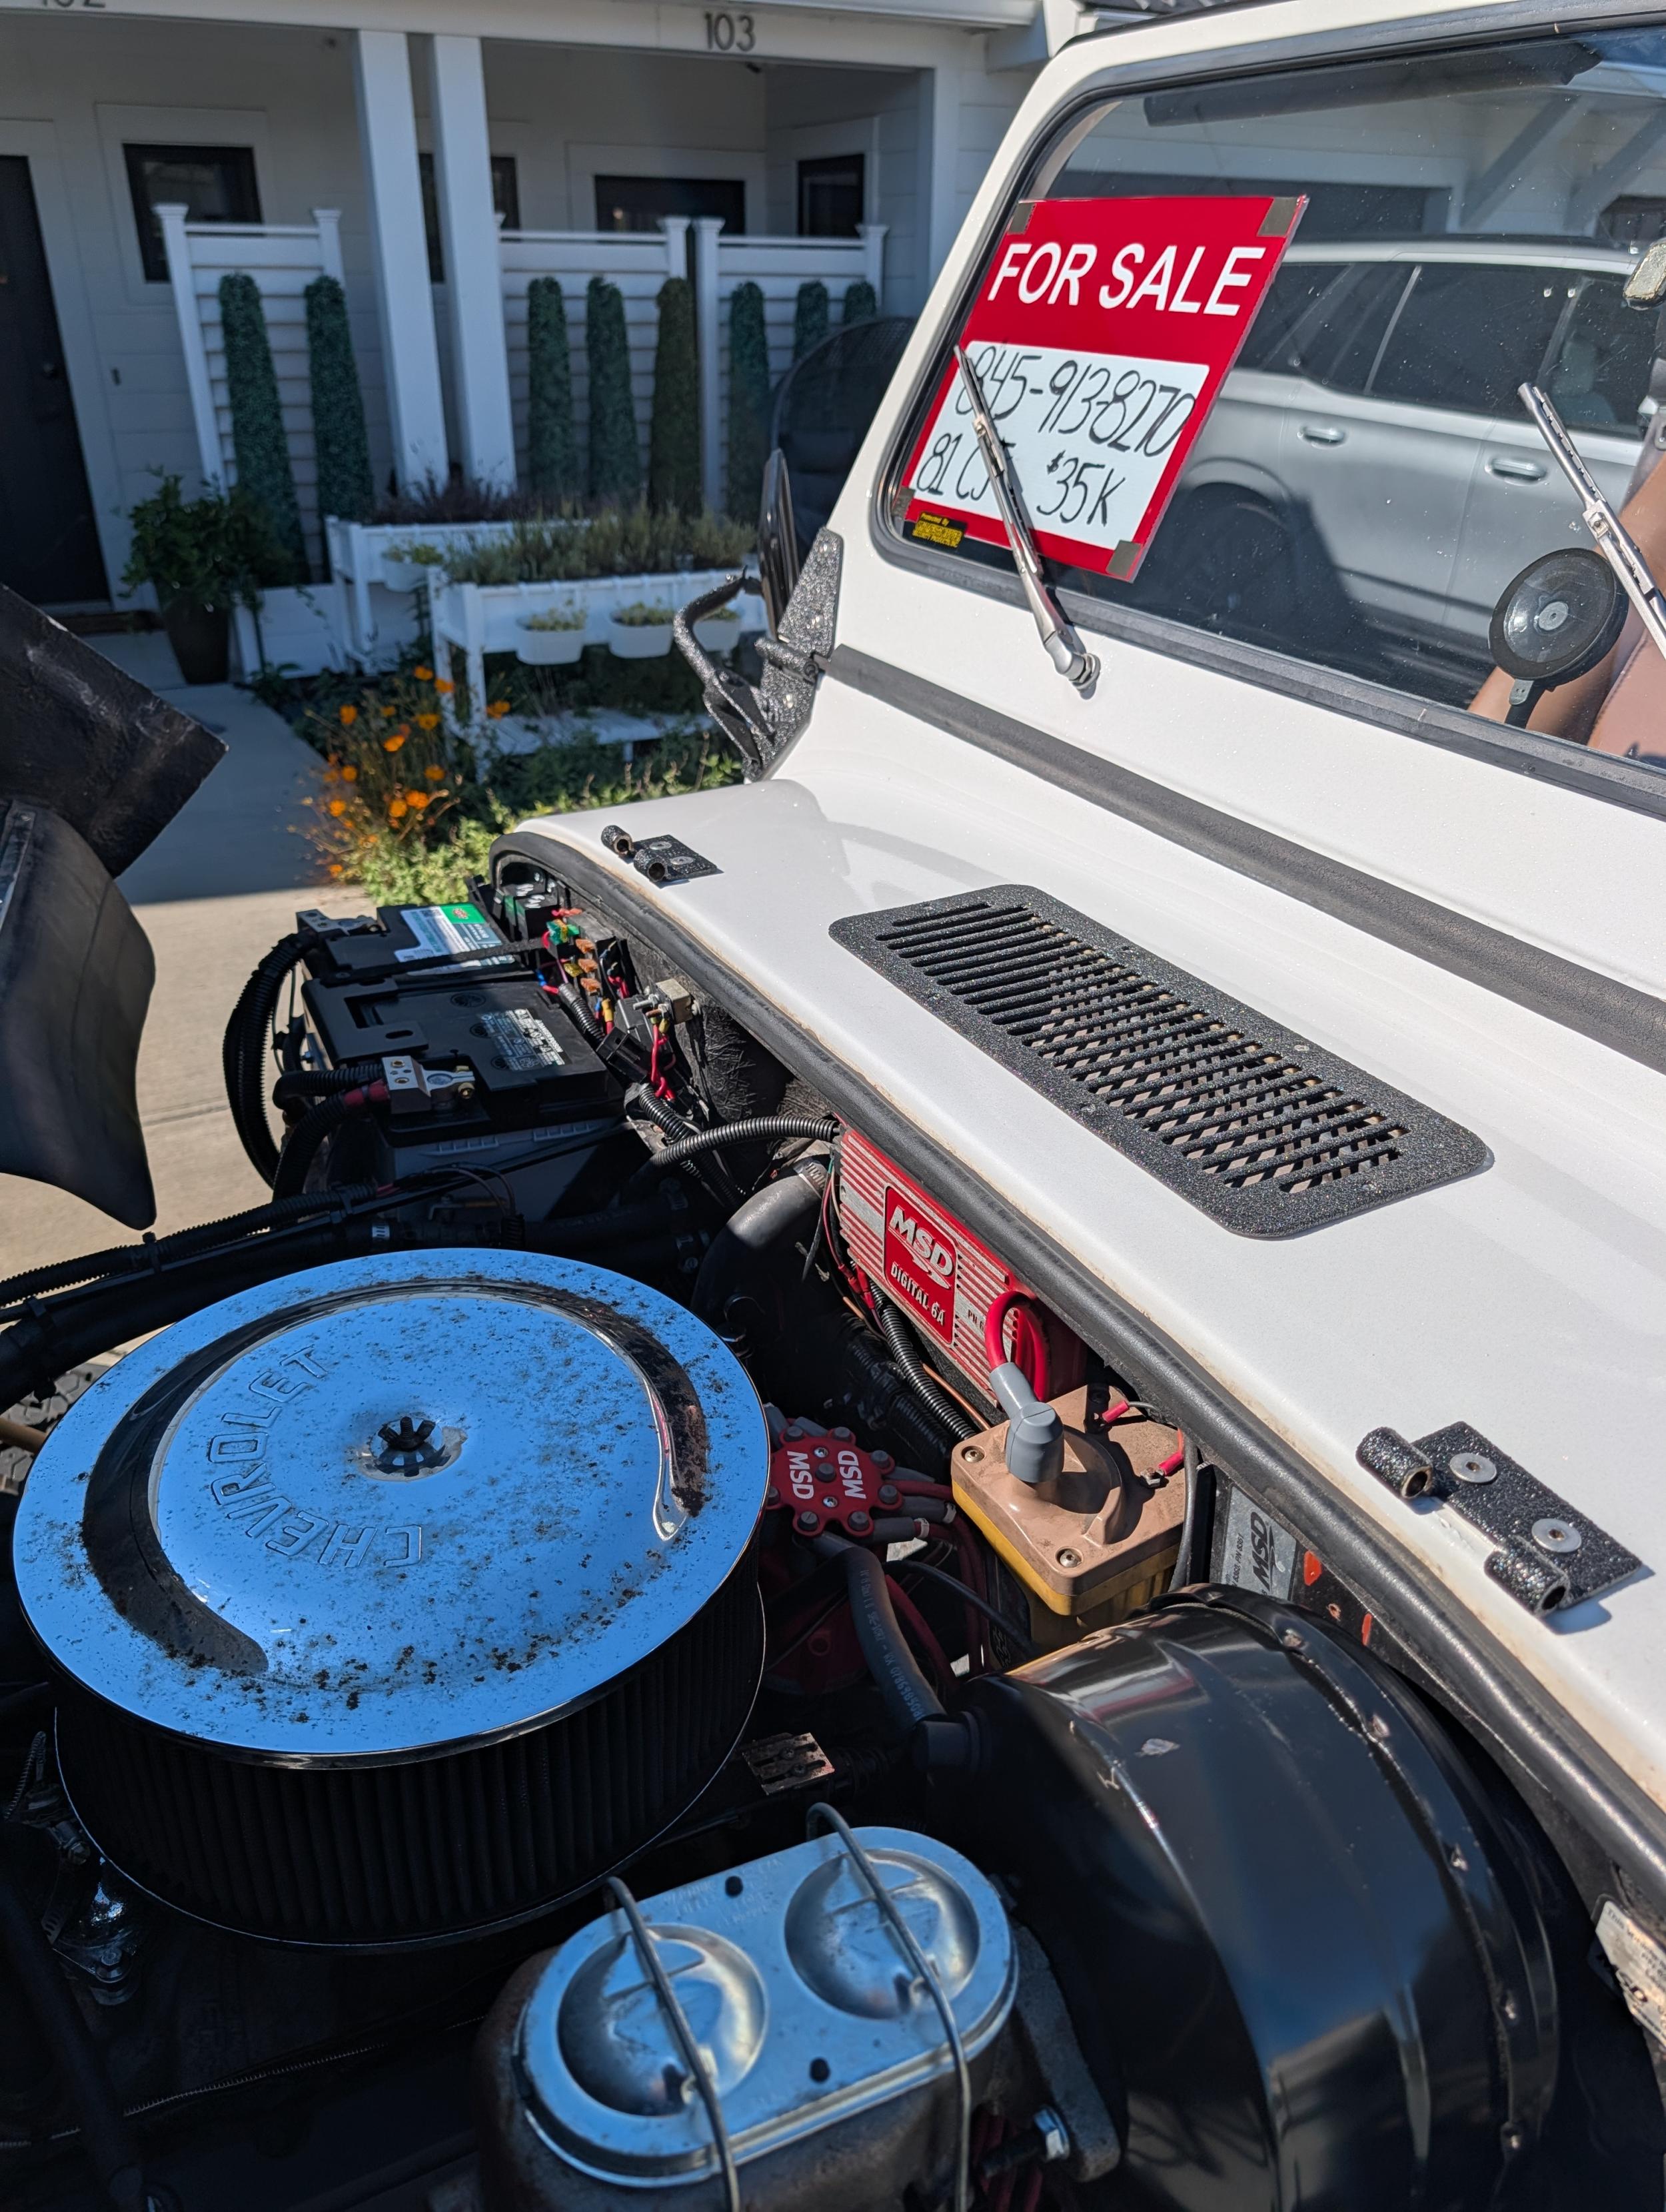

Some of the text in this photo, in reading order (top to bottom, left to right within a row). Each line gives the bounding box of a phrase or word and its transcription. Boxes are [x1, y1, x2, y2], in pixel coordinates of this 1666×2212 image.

[704, 12, 756, 51] 103
[988, 242, 1266, 316] FOR SALE
[916, 432, 963, 496] 81
[889, 1205, 953, 1276] MSD
[890, 1261, 946, 1326] DIGITAL 6A
[208, 1345, 422, 1568] CHEVROLET
[787, 1450, 814, 1499] MSD
[838, 1450, 866, 1499] MSD
[1251, 1511, 1270, 1592] MSD
